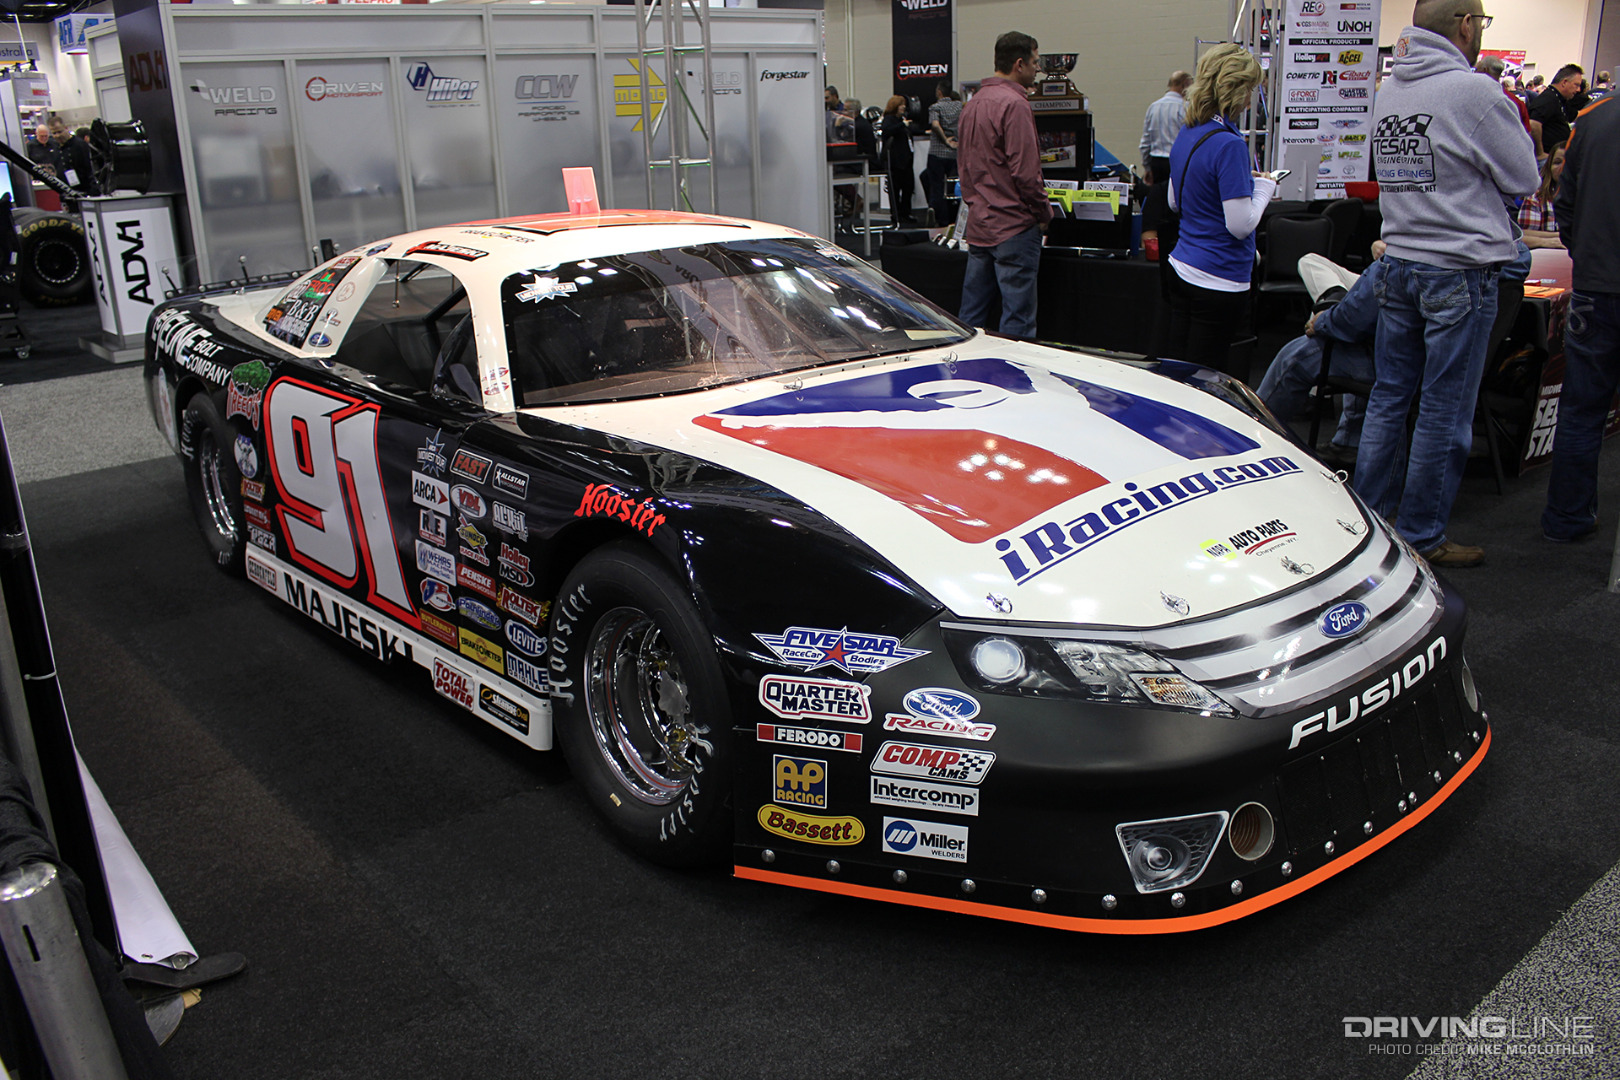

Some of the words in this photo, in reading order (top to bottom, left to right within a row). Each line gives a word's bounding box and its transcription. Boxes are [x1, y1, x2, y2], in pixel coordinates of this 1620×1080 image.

[907, 0, 948, 10] WELD
[1337, 20, 1372, 32] UNOH
[1295, 53, 1316, 62] Holley
[1338, 54, 1361, 64] ACCEL
[760, 70, 810, 81] forgestar
[900, 64, 948, 75] DRIVEN
[1286, 72, 1320, 80] COMETIC
[210, 87, 276, 104] WELD
[311, 82, 384, 94] DRIVEN
[426, 77, 479, 101] HiPer
[515, 75, 579, 99] CCW
[215, 107, 277, 116] RACING
[1373, 139, 1420, 155] TESAR
[1398, 169, 1432, 178] ENGINES
[287, 299, 319, 323] B&B
[193, 339, 224, 358] BOLT
[185, 353, 232, 386] COMPANY
[454, 454, 487, 477] FAST
[500, 472, 526, 487] ALLSTAR
[265, 377, 420, 632] 91
[414, 479, 437, 507] ARCA
[459, 488, 480, 512] VDL
[573, 483, 666, 537] Hoosier
[995, 456, 1300, 581] iRacing.com
[460, 528, 485, 545] SUNOCO
[1229, 529, 1260, 550] AUTO
[1254, 518, 1289, 538] PARTS
[428, 549, 452, 568] WEHRS
[460, 547, 474, 556] RACE
[474, 552, 489, 565] FUELS
[501, 543, 529, 571] Holley
[1206, 543, 1232, 558] NAPA
[461, 566, 492, 588] PENSKE
[500, 563, 531, 584] MSD
[502, 588, 541, 617] ROLTEK
[284, 572, 414, 664] MAJESKI
[1329, 607, 1360, 632] Ford
[508, 622, 544, 655] CLEVITE
[549, 584, 592, 708] Hoosier
[784, 629, 842, 650] FIVE
[843, 634, 897, 656] STAR
[781, 647, 823, 663] RaceCar
[849, 653, 886, 670] Bodies
[435, 661, 467, 694] TOTAL
[508, 656, 548, 687] MAHLE
[508, 667, 549, 695] ORIGINAL
[435, 680, 474, 708] POWER
[766, 682, 861, 703] QUARTER
[918, 693, 962, 715] Ford
[1288, 635, 1447, 750] FUSION
[781, 695, 864, 717] MASTER
[885, 715, 995, 738] RACING
[777, 728, 841, 750] FERODO
[882, 745, 961, 772] COMP
[776, 759, 825, 792] AP
[928, 766, 971, 780] CAMS
[776, 789, 825, 806] RACING
[873, 778, 975, 810] Intercomp
[767, 811, 853, 843] Bassett
[920, 832, 964, 853] Miller
[931, 849, 967, 861] WELDERS
